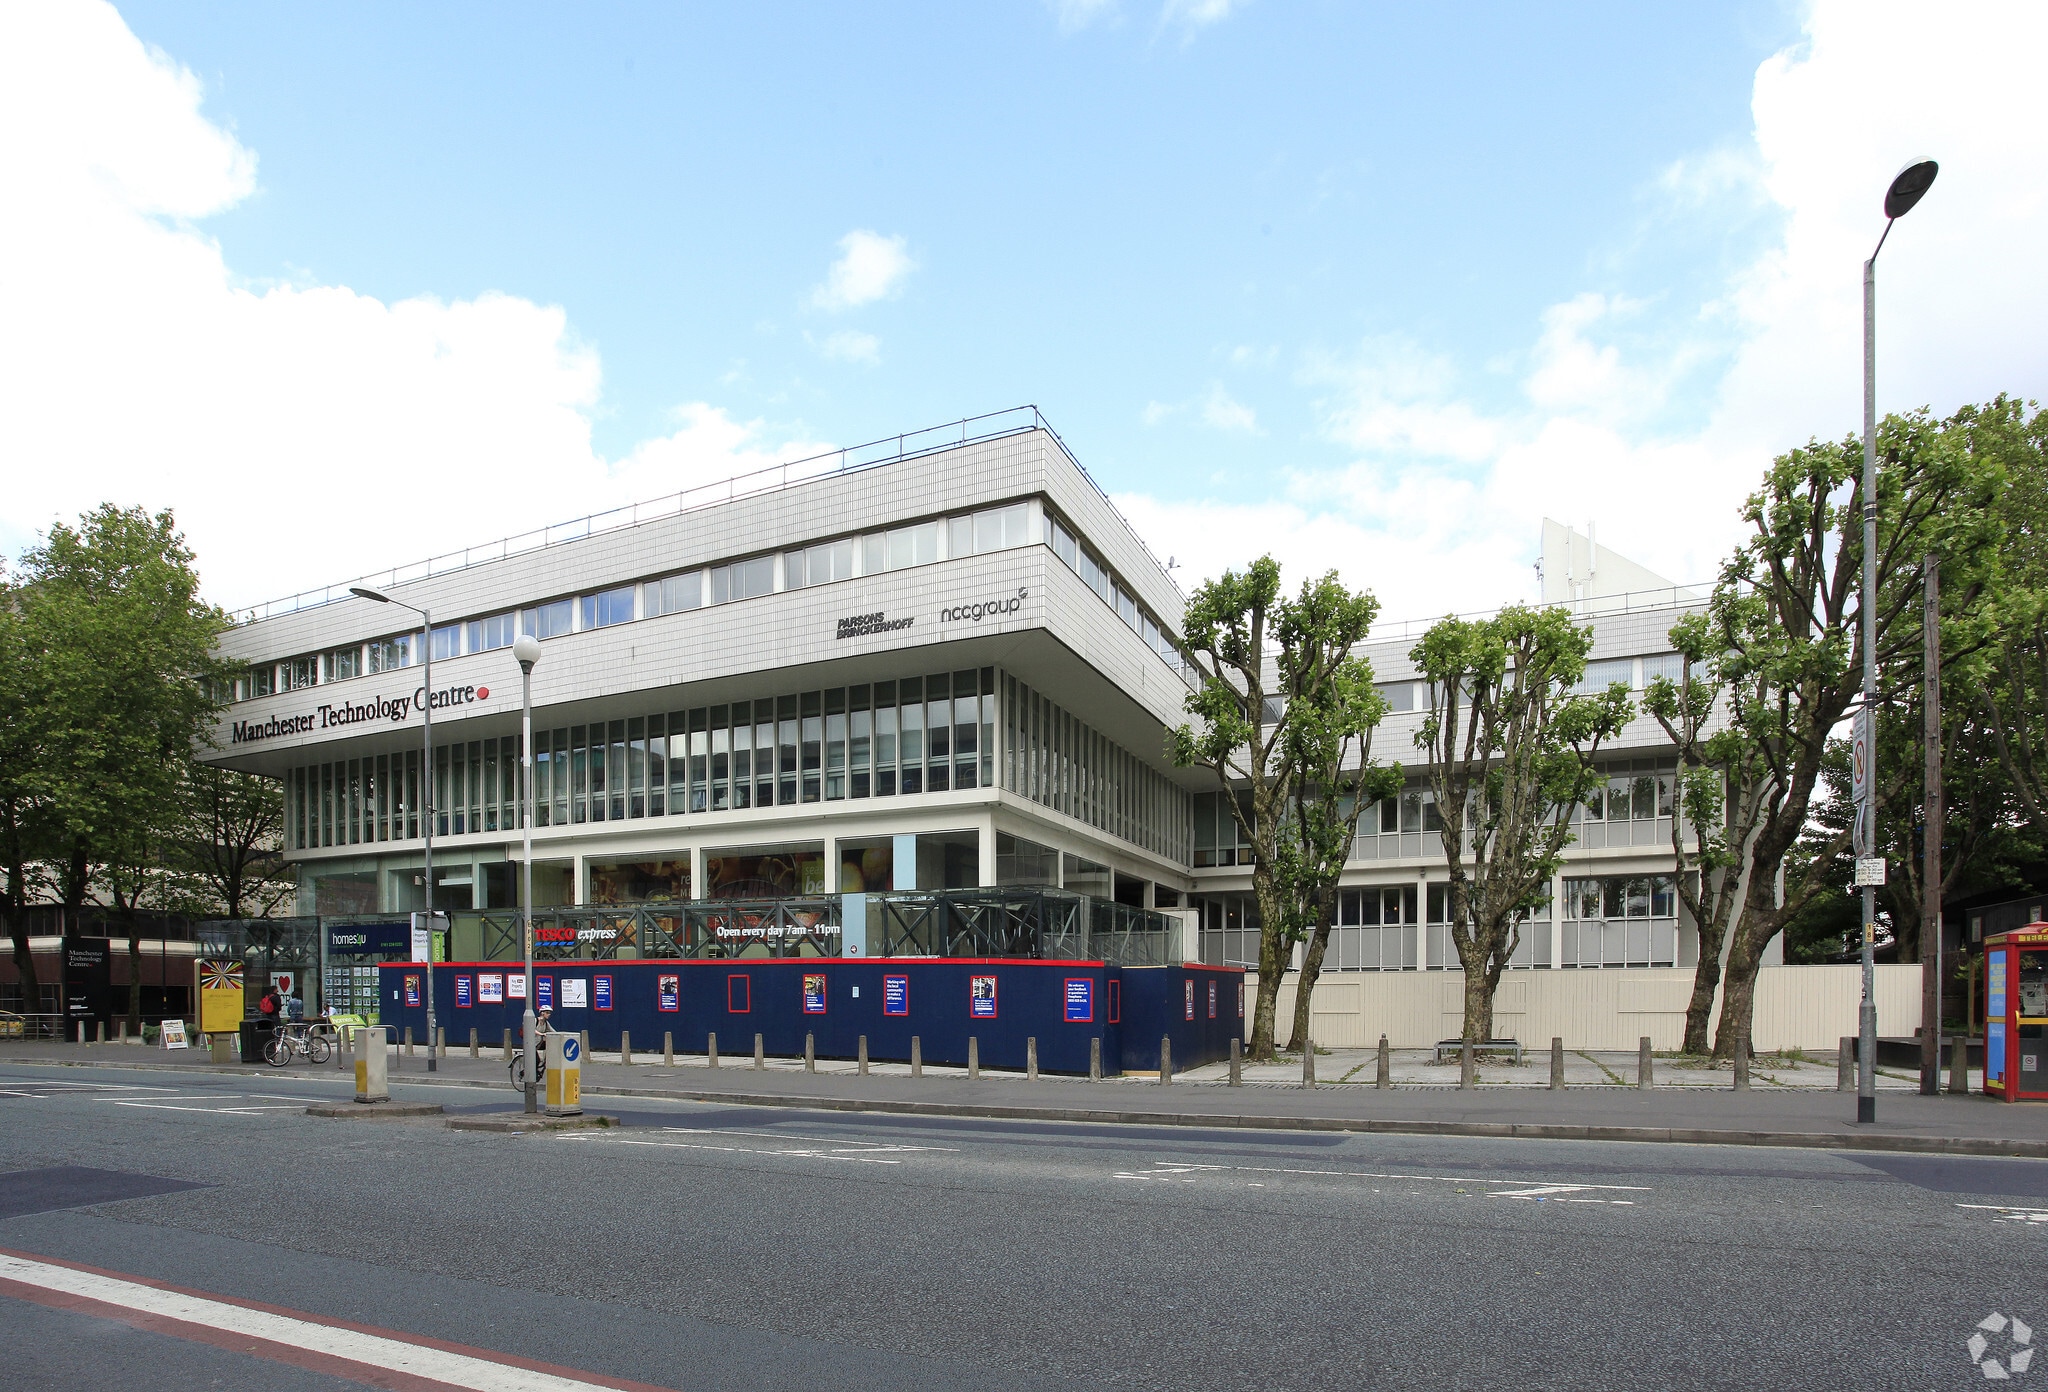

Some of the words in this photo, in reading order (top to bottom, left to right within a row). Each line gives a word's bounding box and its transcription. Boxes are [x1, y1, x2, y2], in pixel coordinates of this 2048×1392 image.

[941, 597, 1021, 622] nccgroup
[836, 617, 914, 640] BRINCKERHOFF
[837, 611, 885, 629] PARSONS
[232, 714, 316, 744] Manchester
[317, 695, 411, 728] Technology
[414, 684, 475, 712] Centre
[534, 927, 576, 941] TESCO
[577, 928, 617, 943] express
[716, 926, 741, 938] Open
[741, 926, 766, 938] every
[767, 925, 784, 938] day
[785, 924, 806, 935] 7am
[814, 923, 840, 937] 11pm
[68, 955, 102, 963] Technology
